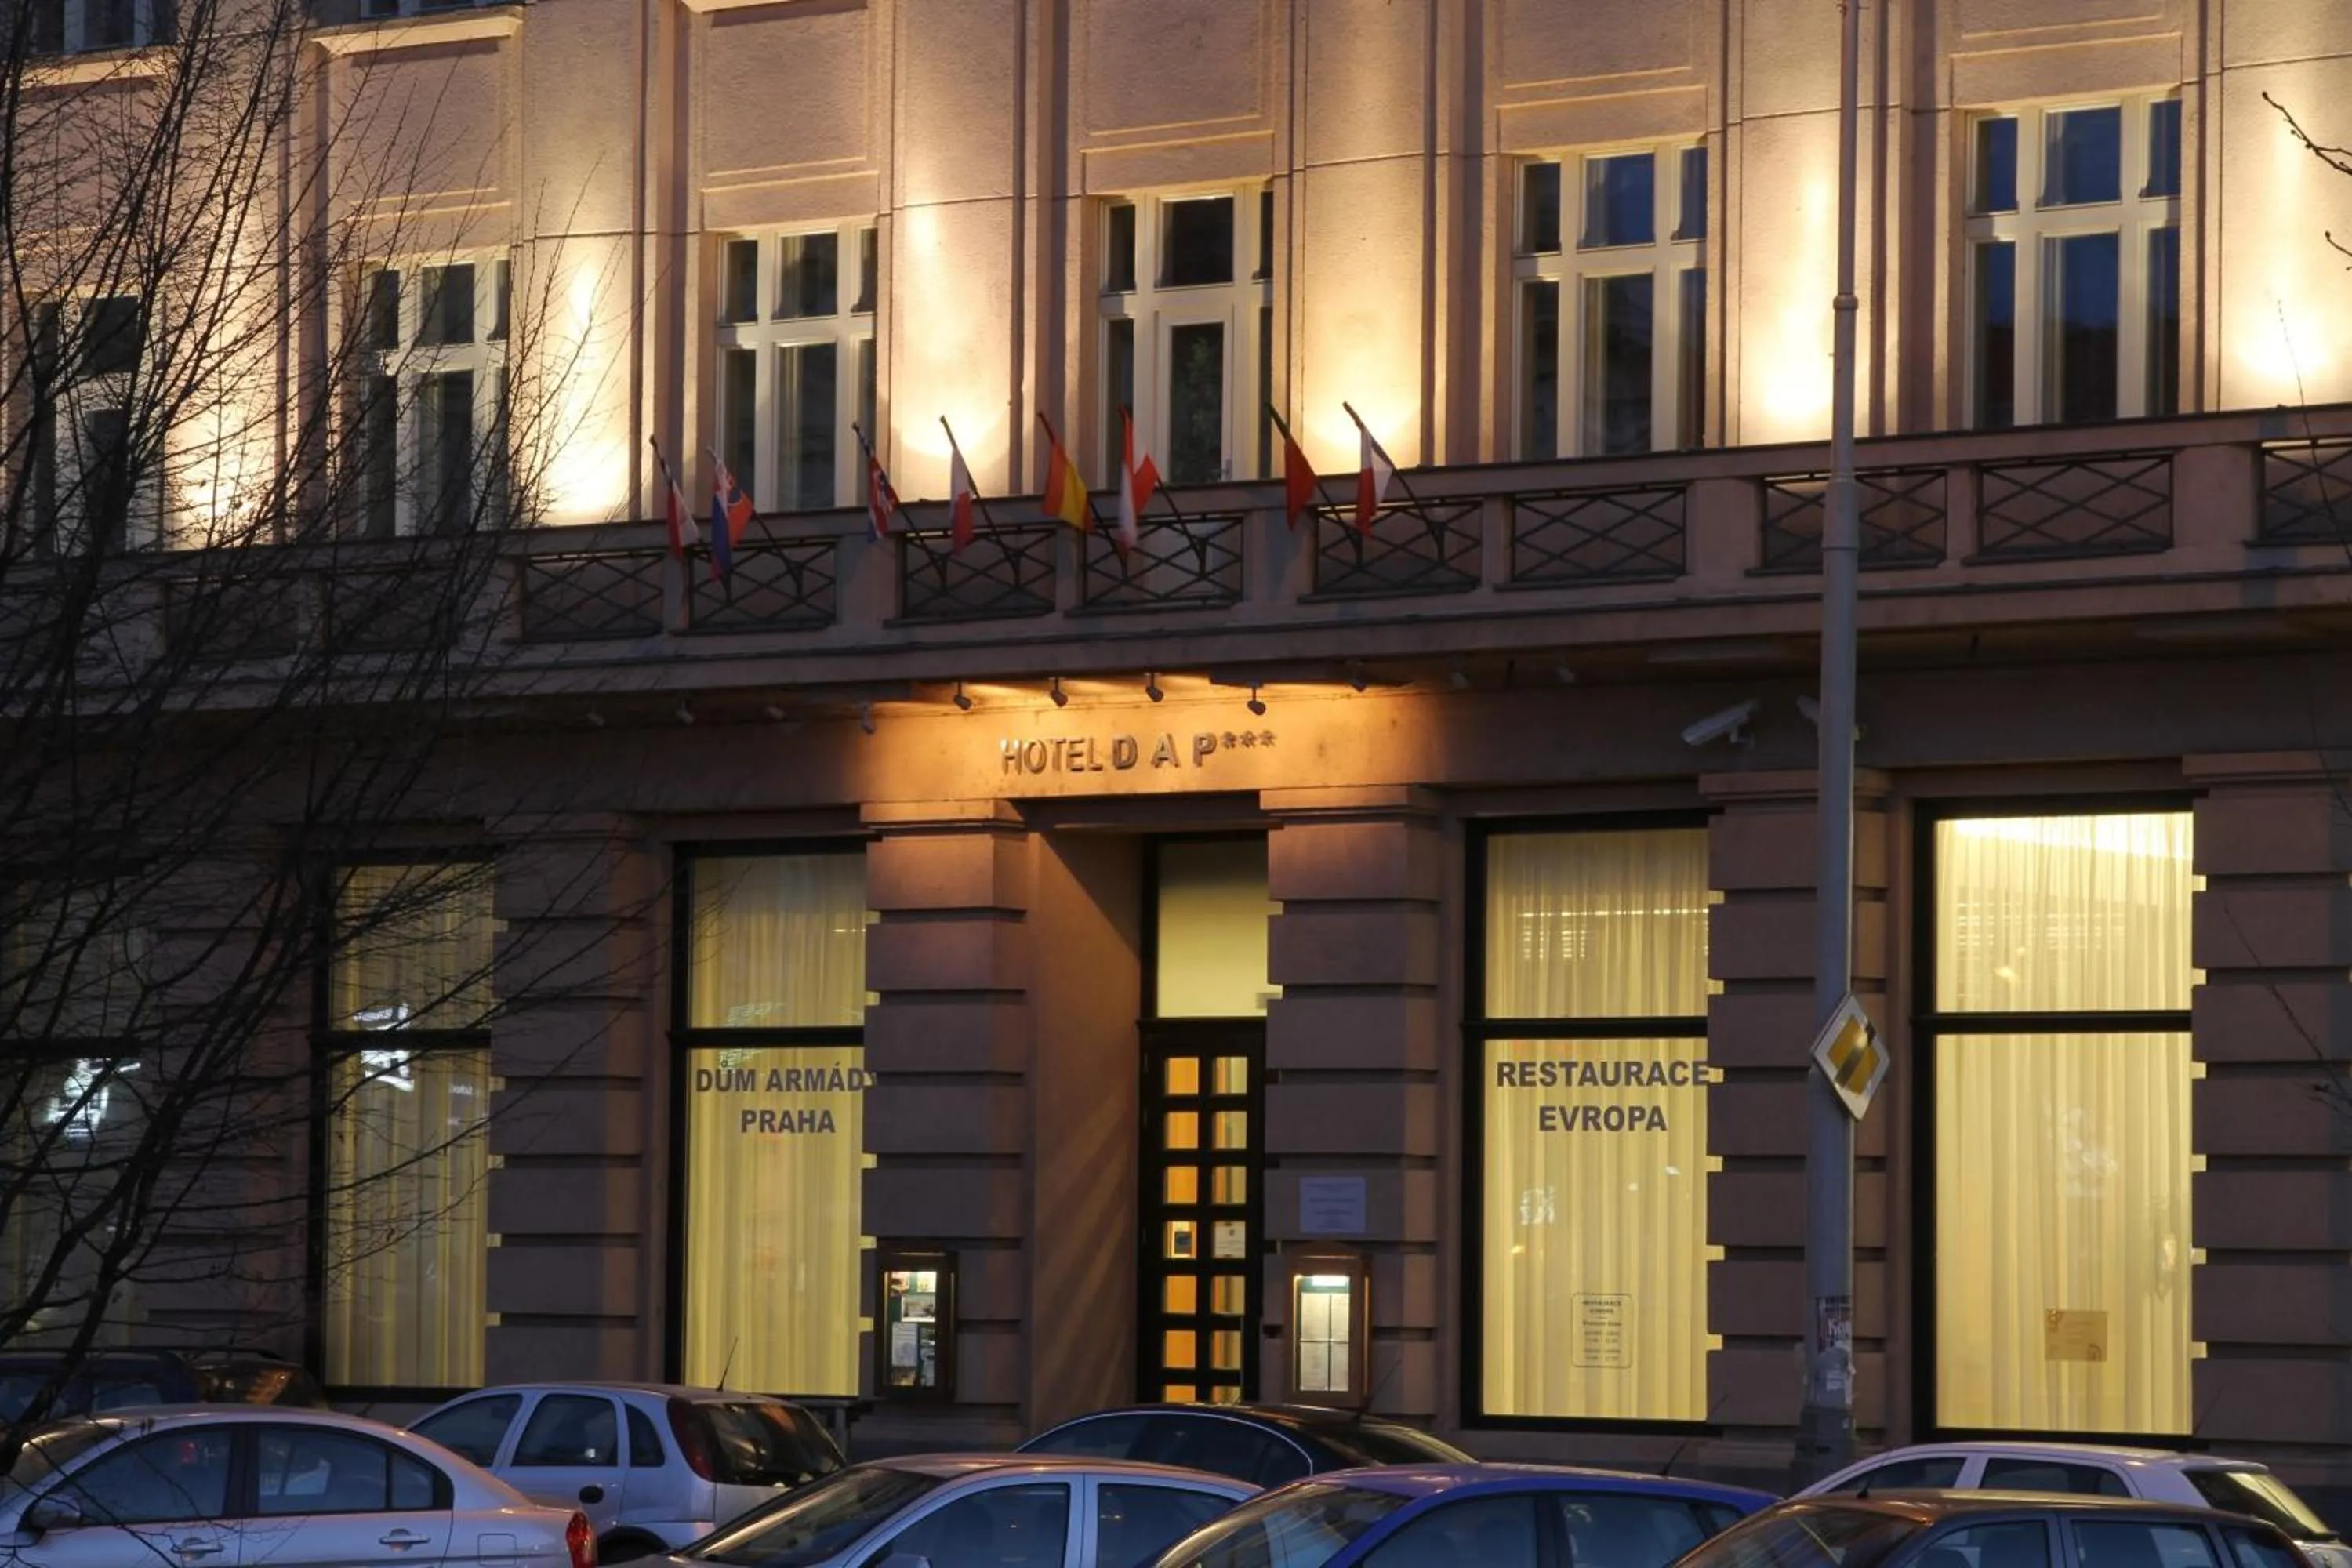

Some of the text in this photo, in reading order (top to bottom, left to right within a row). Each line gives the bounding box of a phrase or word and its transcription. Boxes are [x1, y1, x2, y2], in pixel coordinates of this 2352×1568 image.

[1000, 737, 1104, 775] HOTEL
[765, 1062, 876, 1092] ARMÁD
[1497, 1061, 1710, 1087] RESTAURACE
[741, 1109, 837, 1134] PRAHA
[1539, 1105, 1668, 1132] EVROPA
